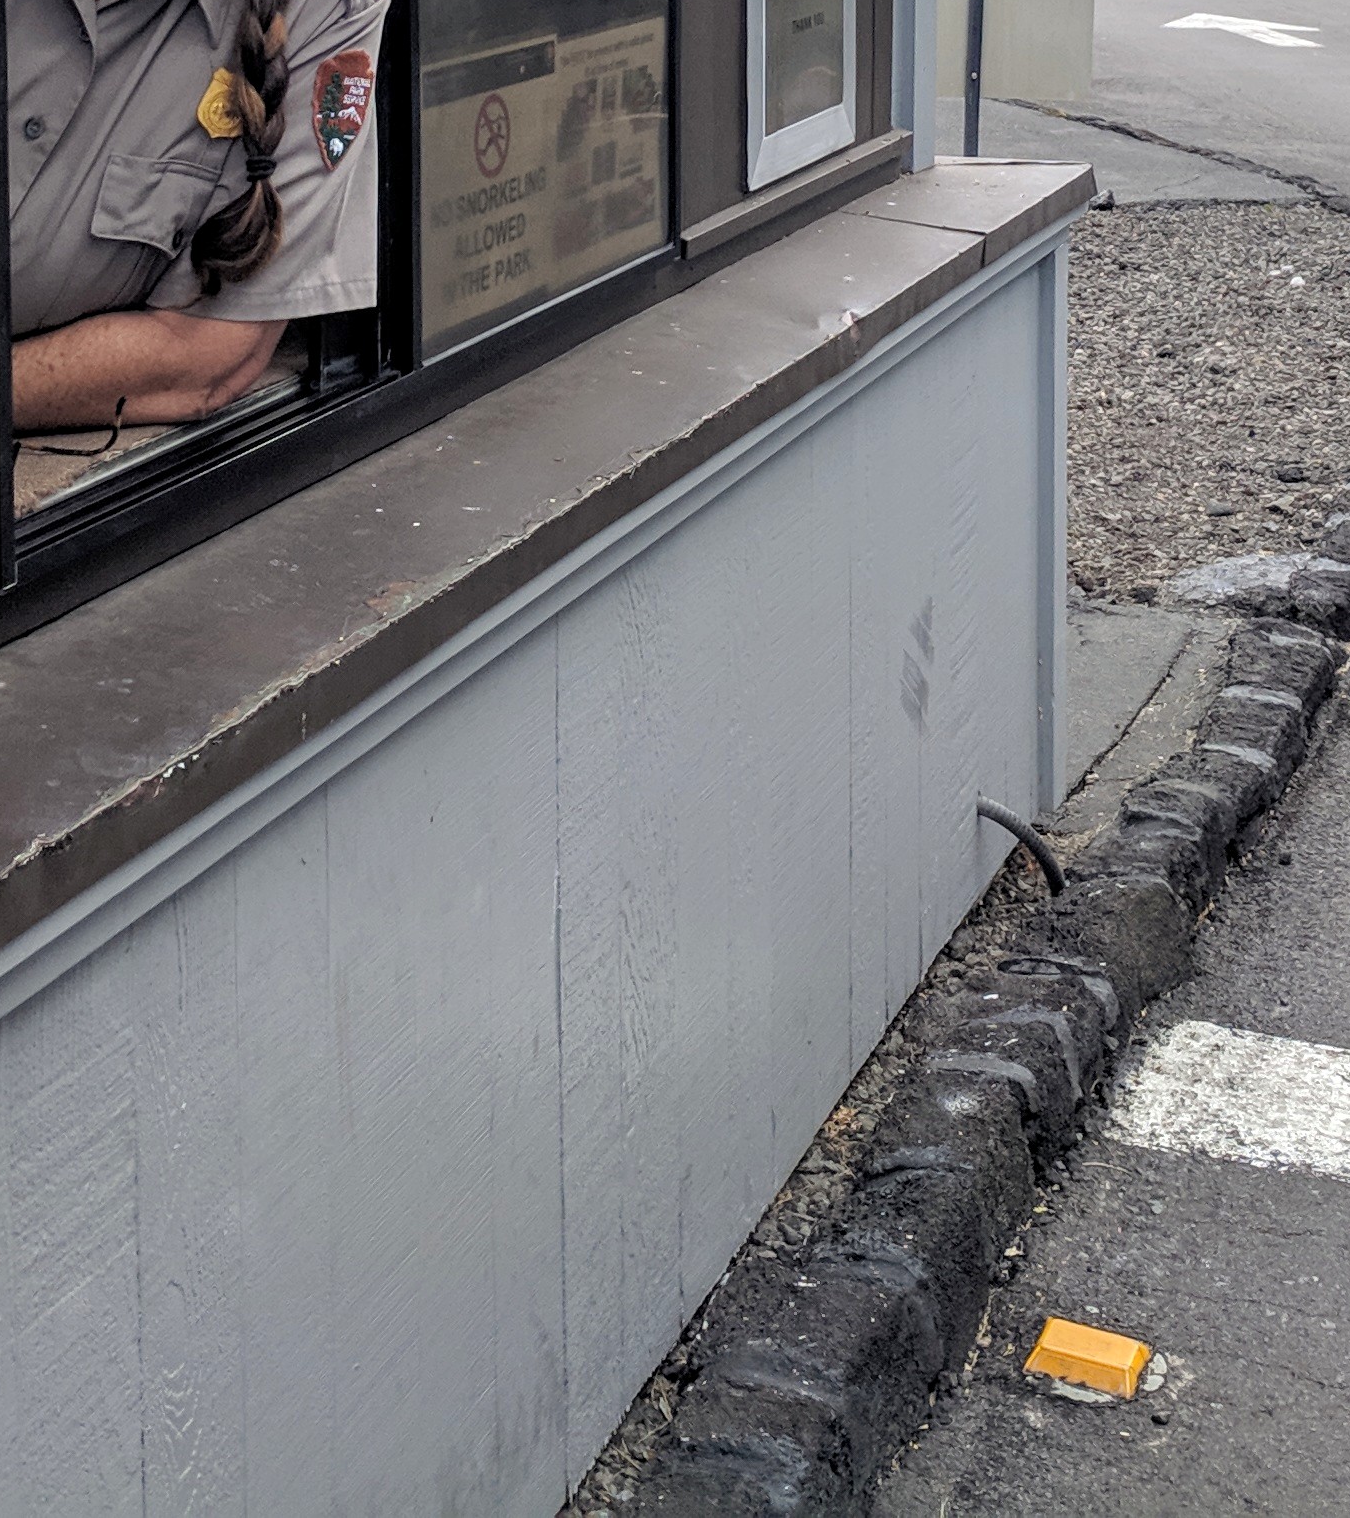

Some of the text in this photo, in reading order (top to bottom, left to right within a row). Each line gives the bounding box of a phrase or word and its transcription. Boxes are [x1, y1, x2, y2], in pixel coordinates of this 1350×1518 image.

[430, 165, 548, 229] NO SNORKELING
[454, 213, 527, 260] ALLOWED
[460, 263, 491, 298] THE
[495, 247, 534, 286] PARK
